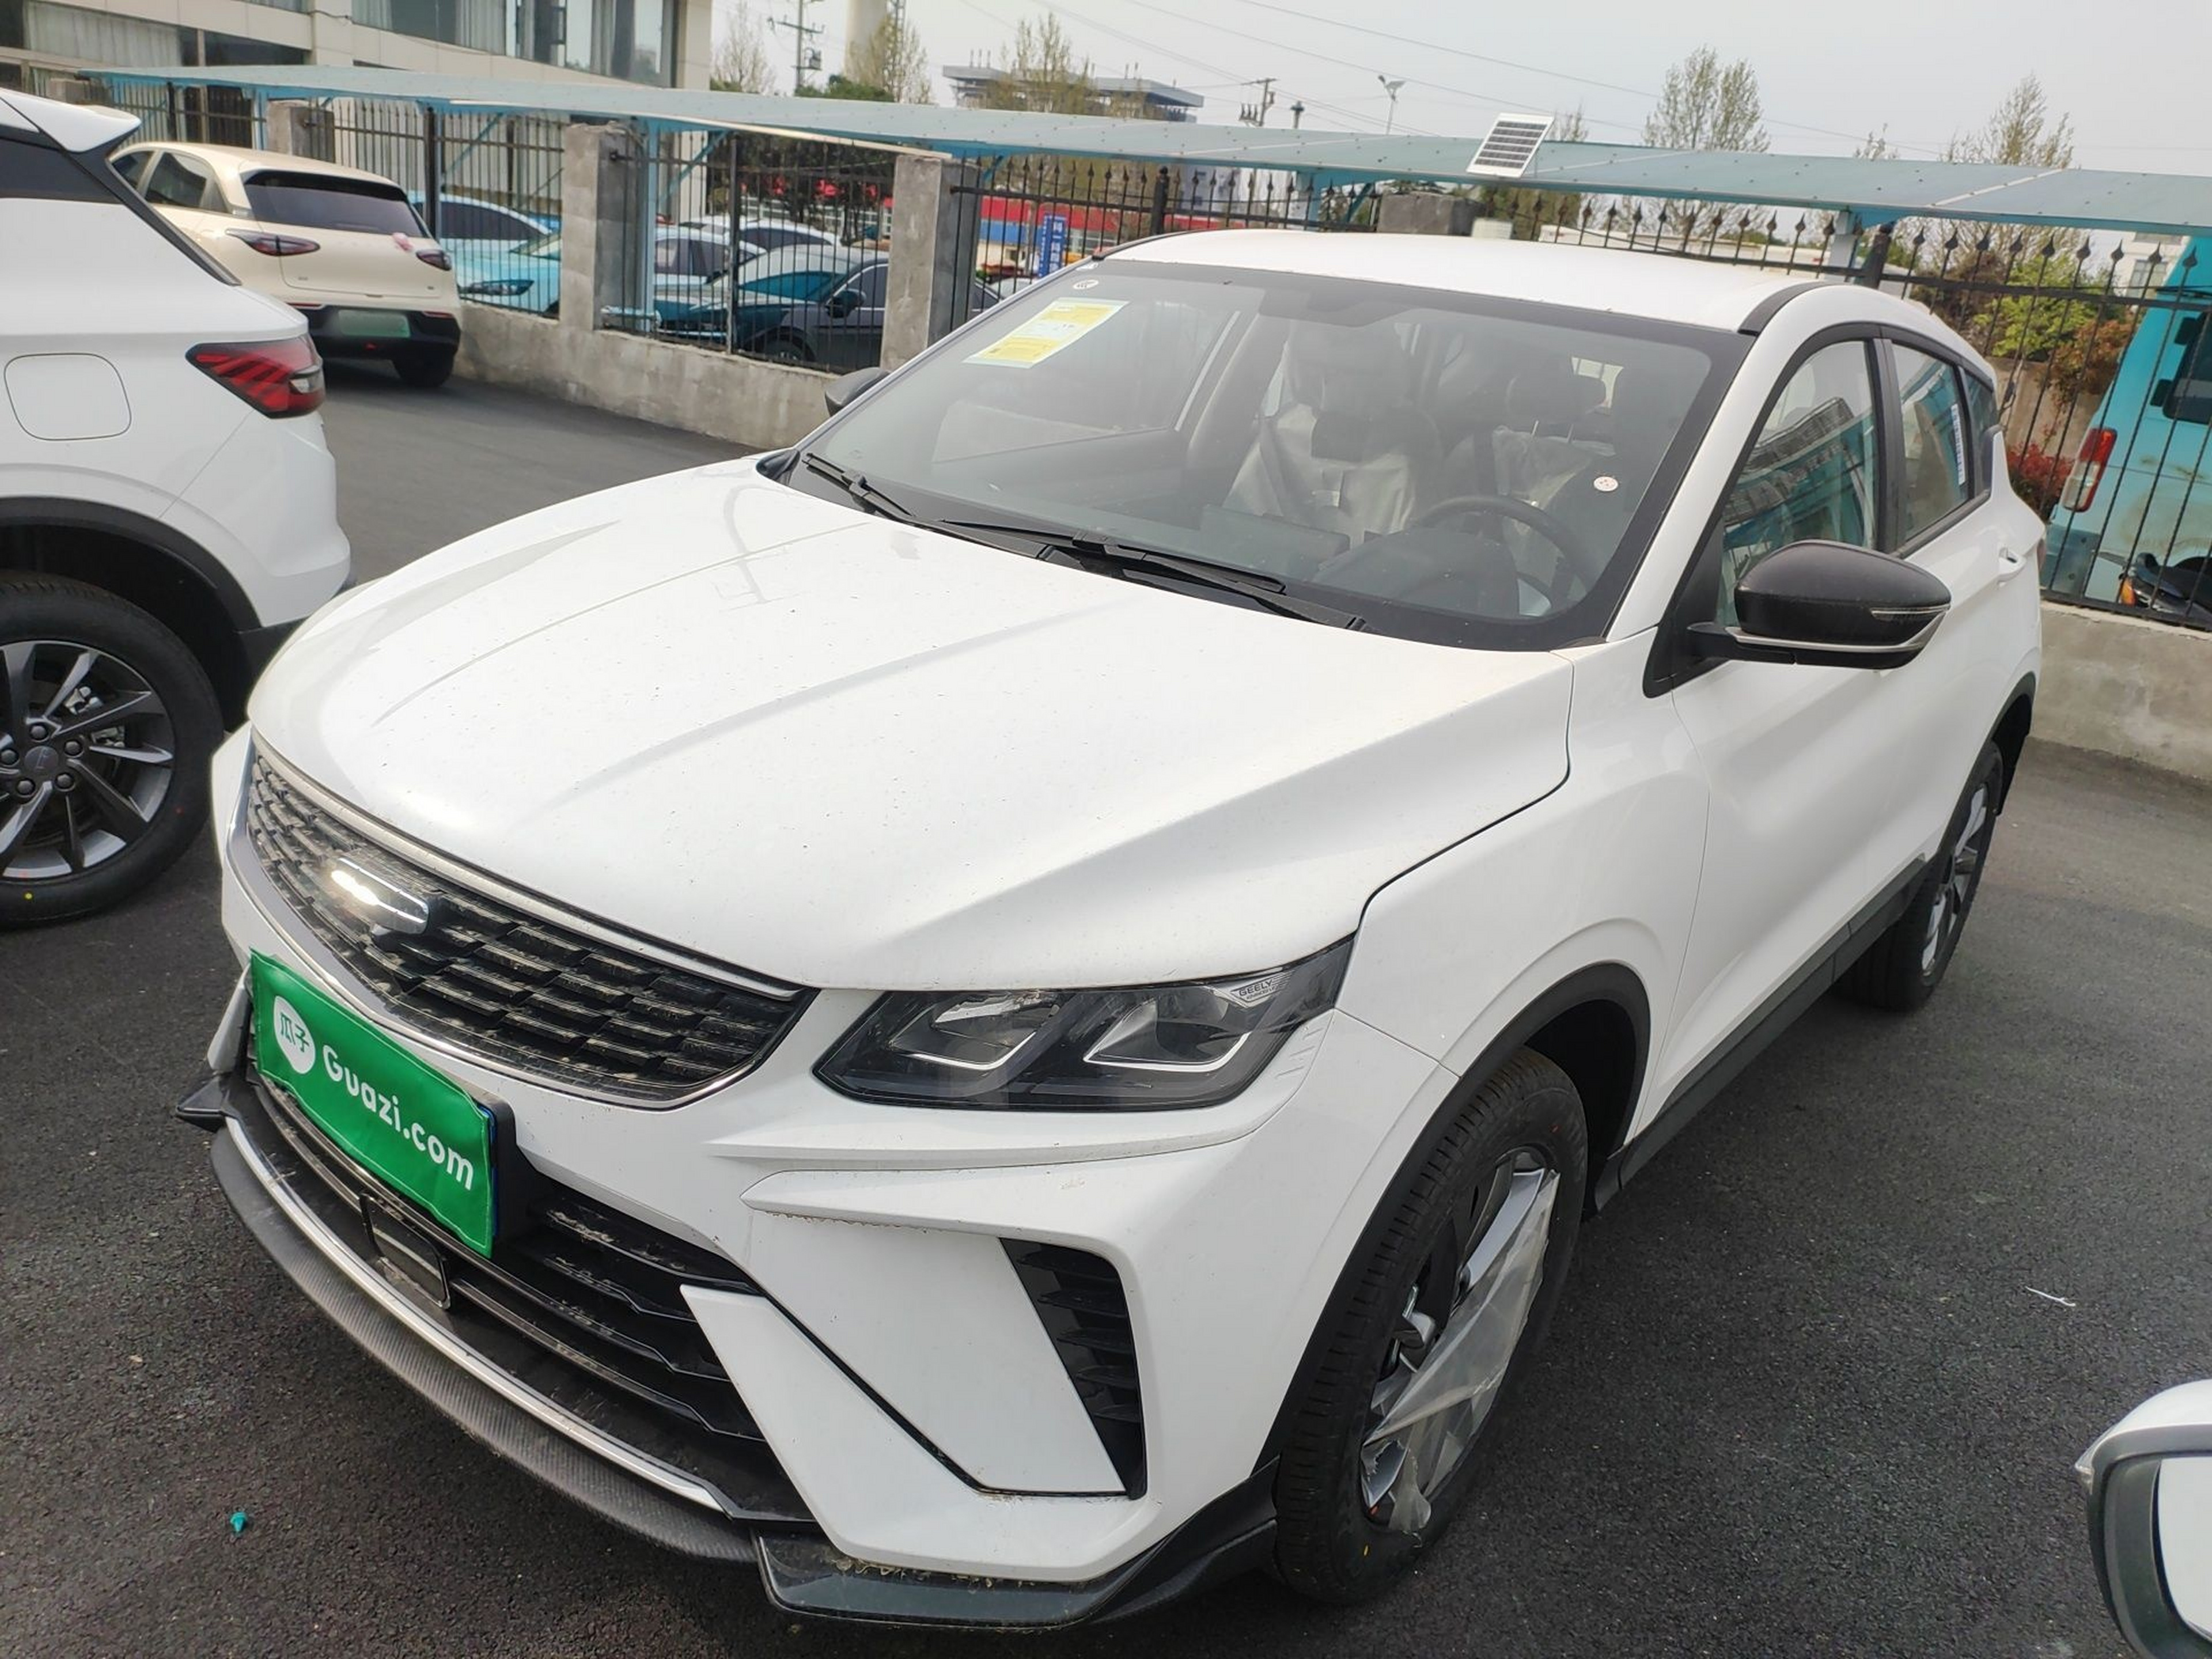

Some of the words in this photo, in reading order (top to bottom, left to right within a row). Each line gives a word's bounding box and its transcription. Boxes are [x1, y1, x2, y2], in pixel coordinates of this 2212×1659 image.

[1239, 979, 1272, 996] GEELY
[280, 1012, 309, 1053] 瓜子
[323, 1044, 474, 1191] Guazi.com
